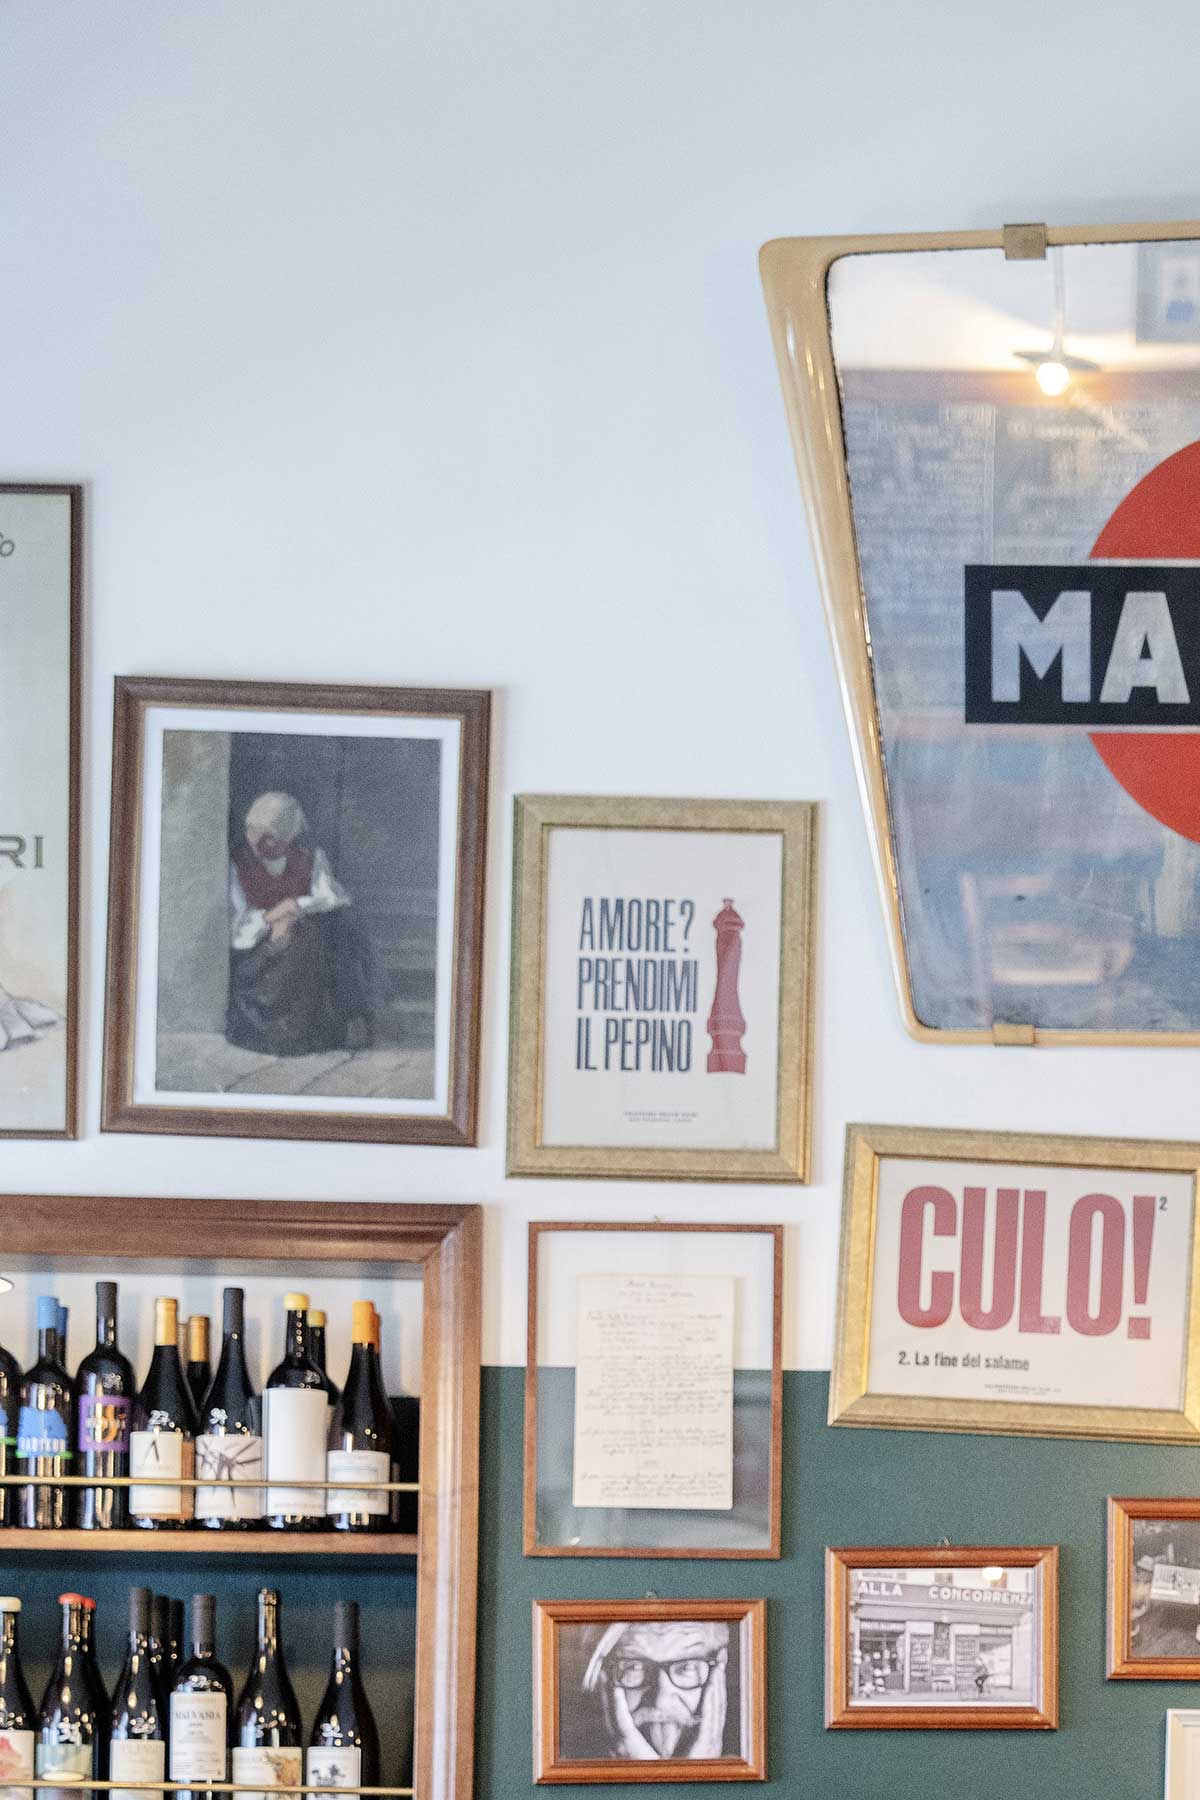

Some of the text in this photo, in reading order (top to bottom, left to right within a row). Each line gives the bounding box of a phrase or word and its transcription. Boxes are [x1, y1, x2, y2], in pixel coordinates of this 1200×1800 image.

[579, 897, 695, 953] AMORE?
[577, 957, 698, 1013] PRENDIMI
[576, 1017, 692, 1072] IL PEPINO
[897, 1185, 1156, 1339] CULO!
[898, 1350, 1029, 1371] 2. La fine del salame
[857, 1581, 903, 1597] ALLA
